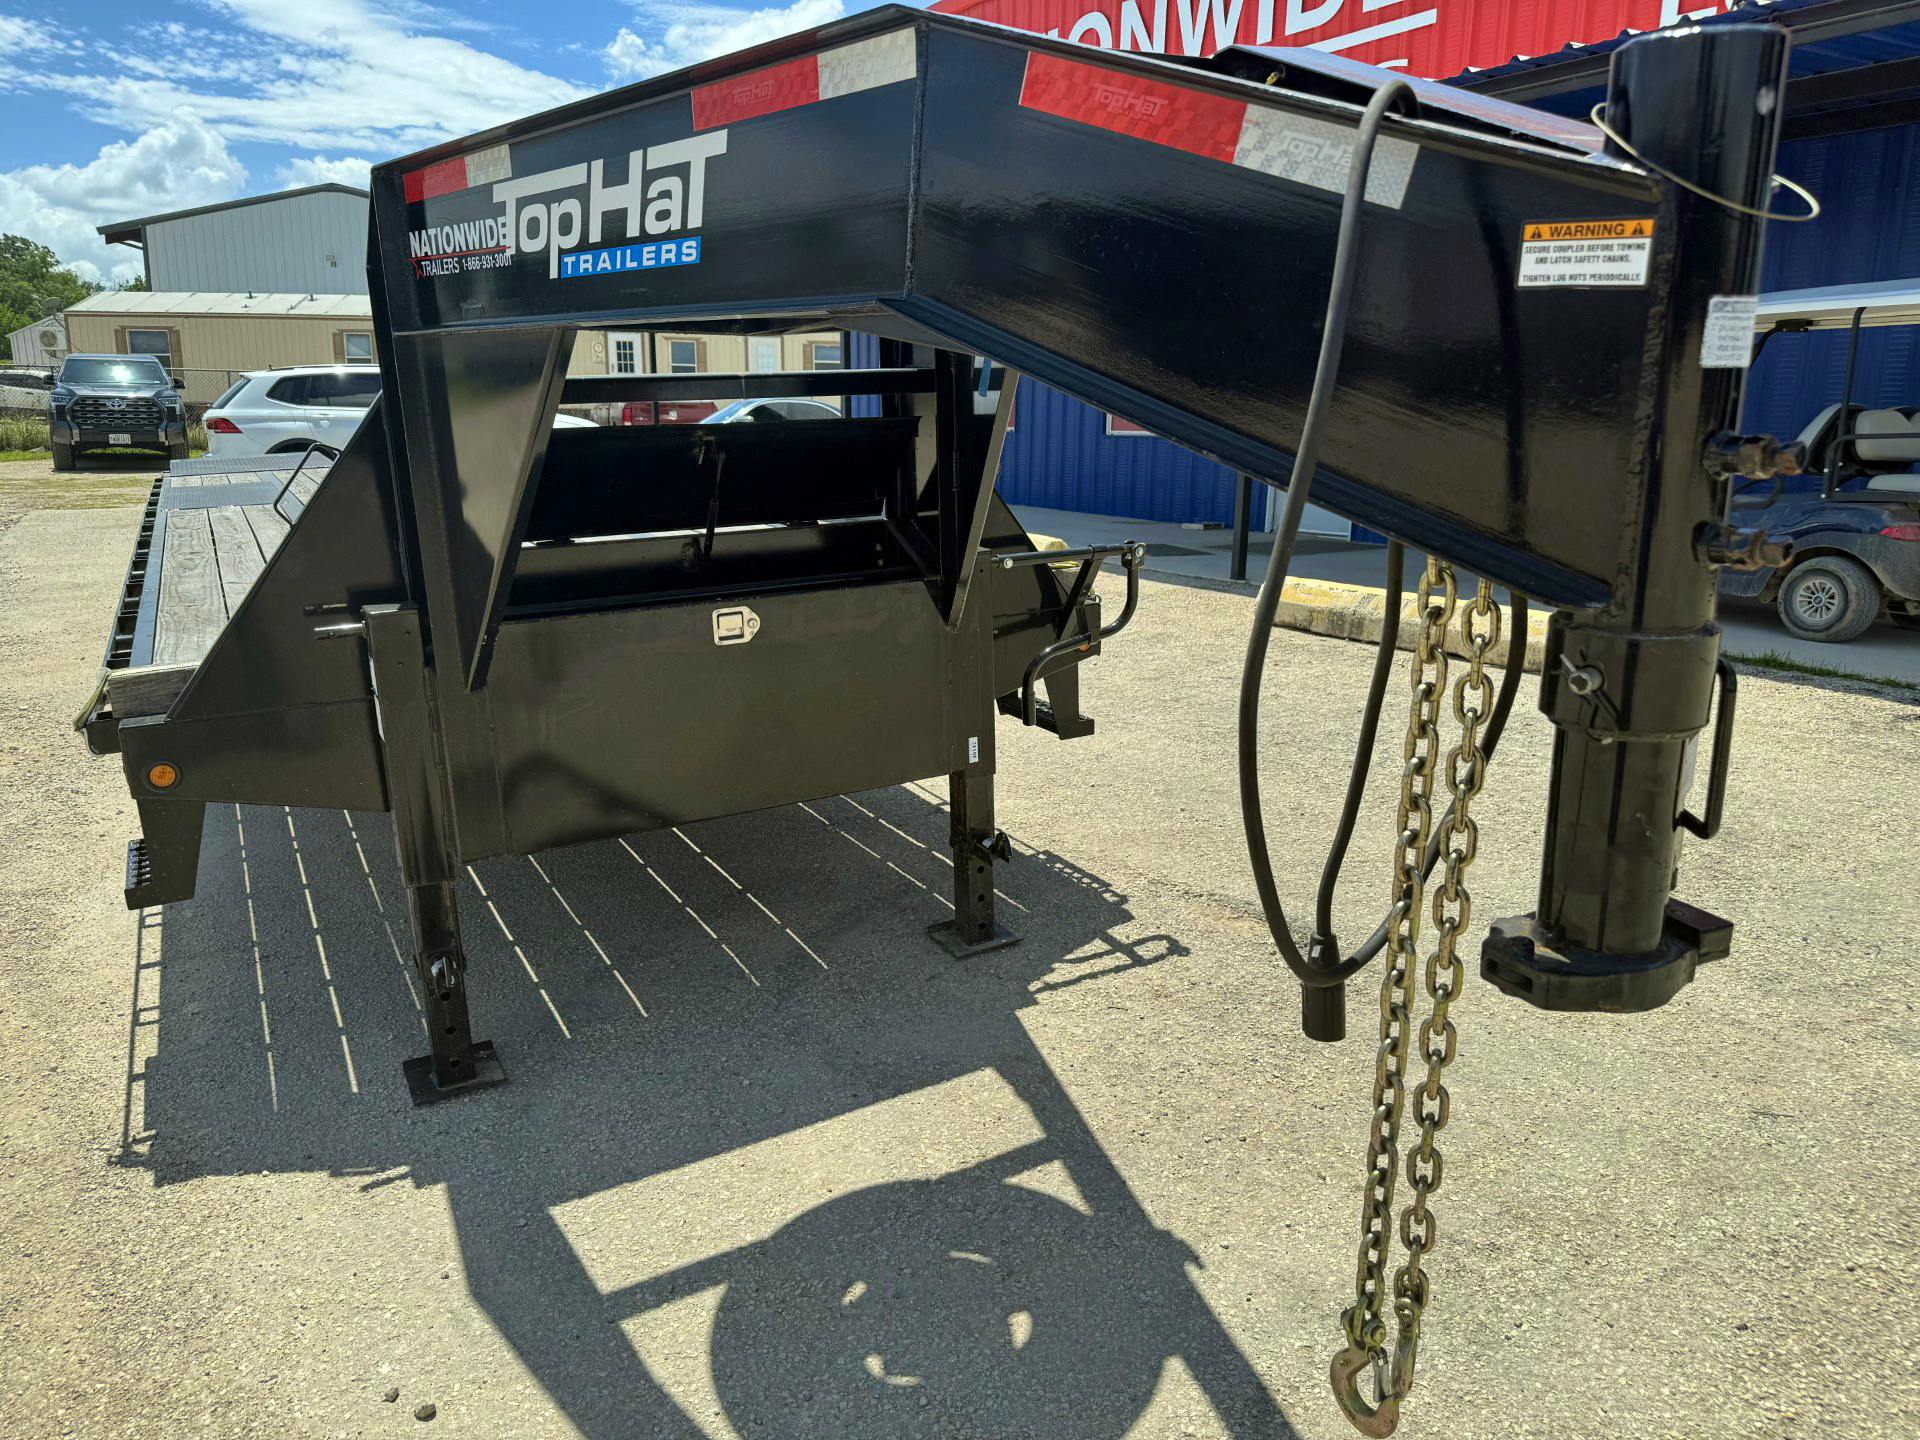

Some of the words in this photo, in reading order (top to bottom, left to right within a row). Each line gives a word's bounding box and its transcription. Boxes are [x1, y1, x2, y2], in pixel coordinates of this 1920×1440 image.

[408, 215, 508, 258] NATIONWIDE
[1549, 223, 1625, 238] WARNING
[1524, 245, 1550, 255] SECURE
[1552, 244, 1585, 254] COUPLER
[1587, 243, 1614, 253] BEFORE
[1616, 242, 1646, 252] TOWING
[563, 240, 697, 275] TRAILERS
[1534, 256, 1548, 265] AND
[1550, 255, 1572, 265] LATCH
[1573, 254, 1601, 264] SAFETY
[420, 257, 460, 277] TRAILERS
[1522, 274, 1551, 283] TIGHTEN
[1552, 274, 1567, 282] LUG
[1568, 273, 1587, 282] NUTS
[1588, 272, 1641, 282] PERIODICALLY.
